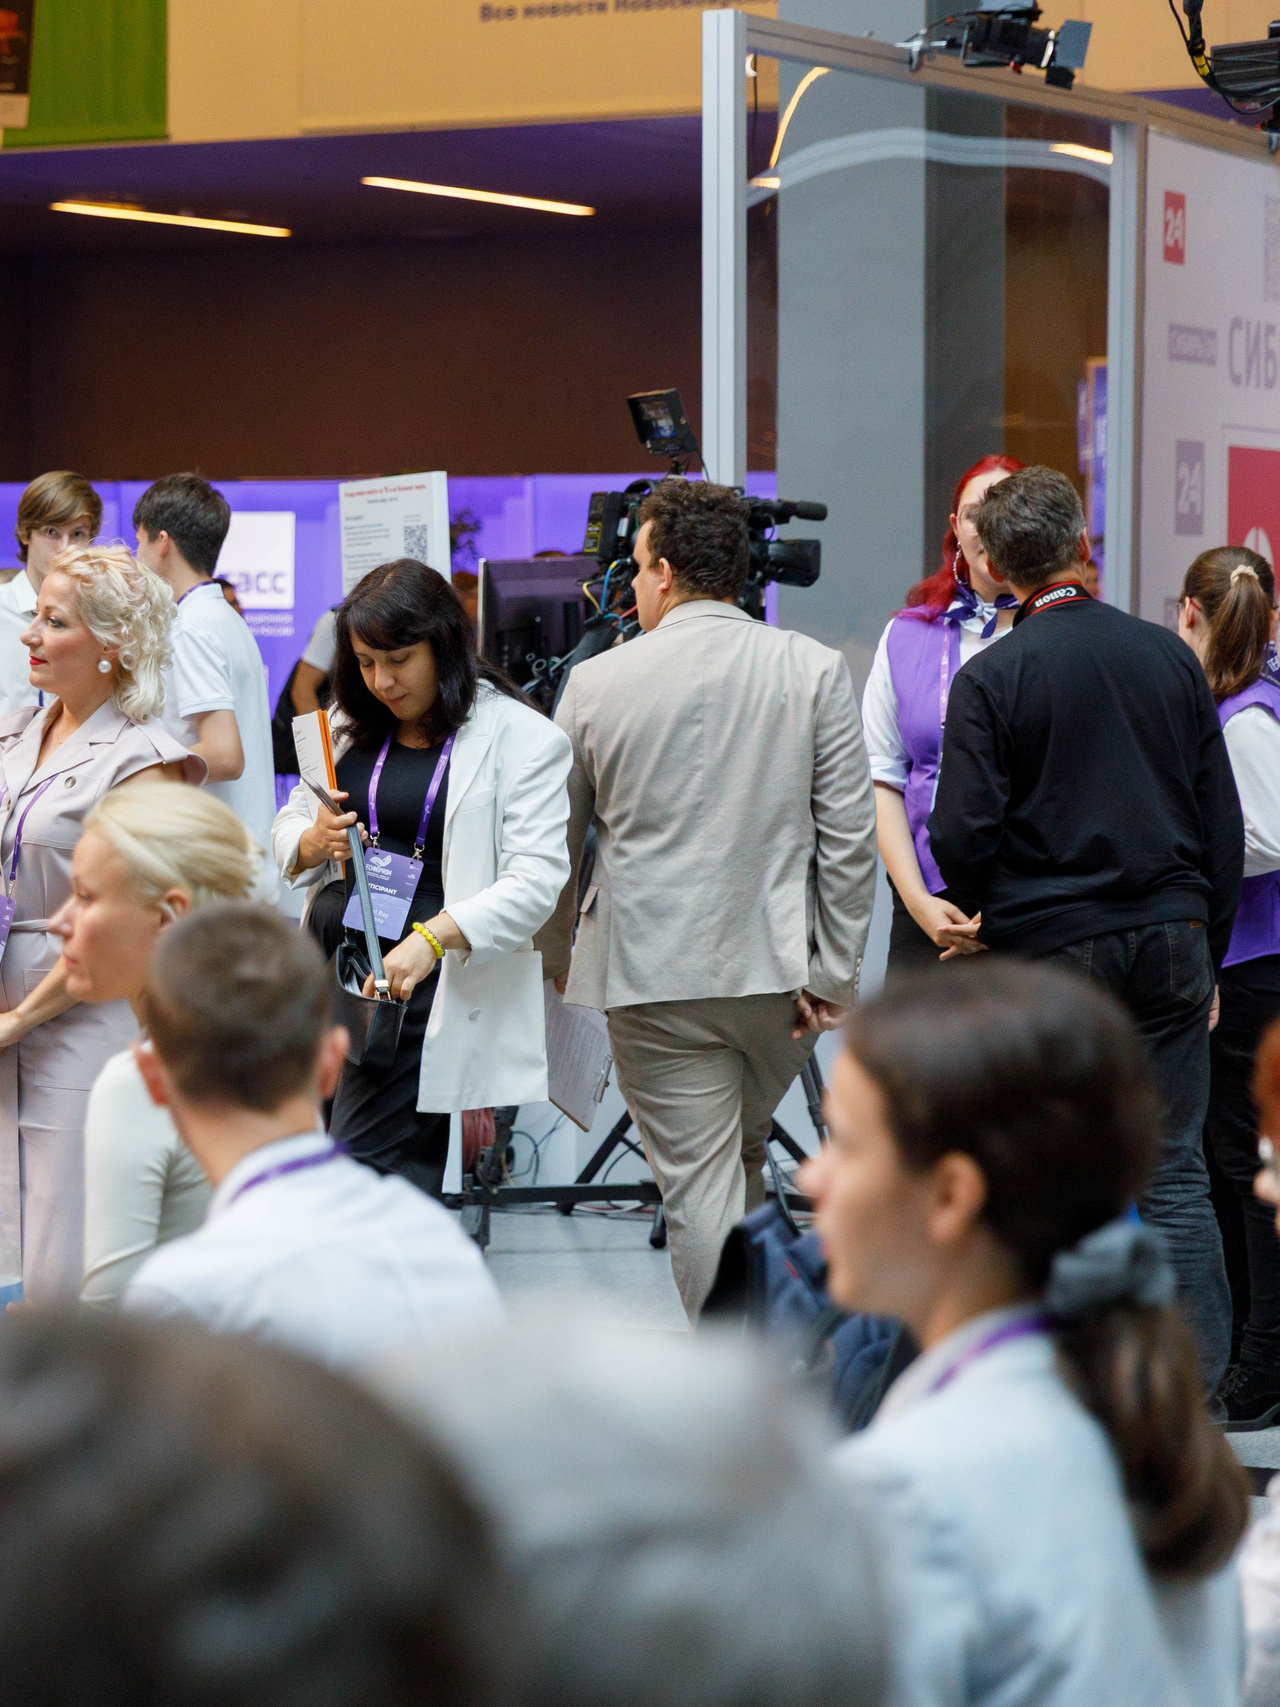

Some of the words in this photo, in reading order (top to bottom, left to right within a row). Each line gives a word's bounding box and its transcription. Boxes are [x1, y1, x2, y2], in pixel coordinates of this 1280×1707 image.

[1166, 207, 1184, 250] 24
[1177, 461, 1203, 517] 24
[1035, 586, 1078, 608] Canon
[369, 883, 397, 895] TICIPANT
